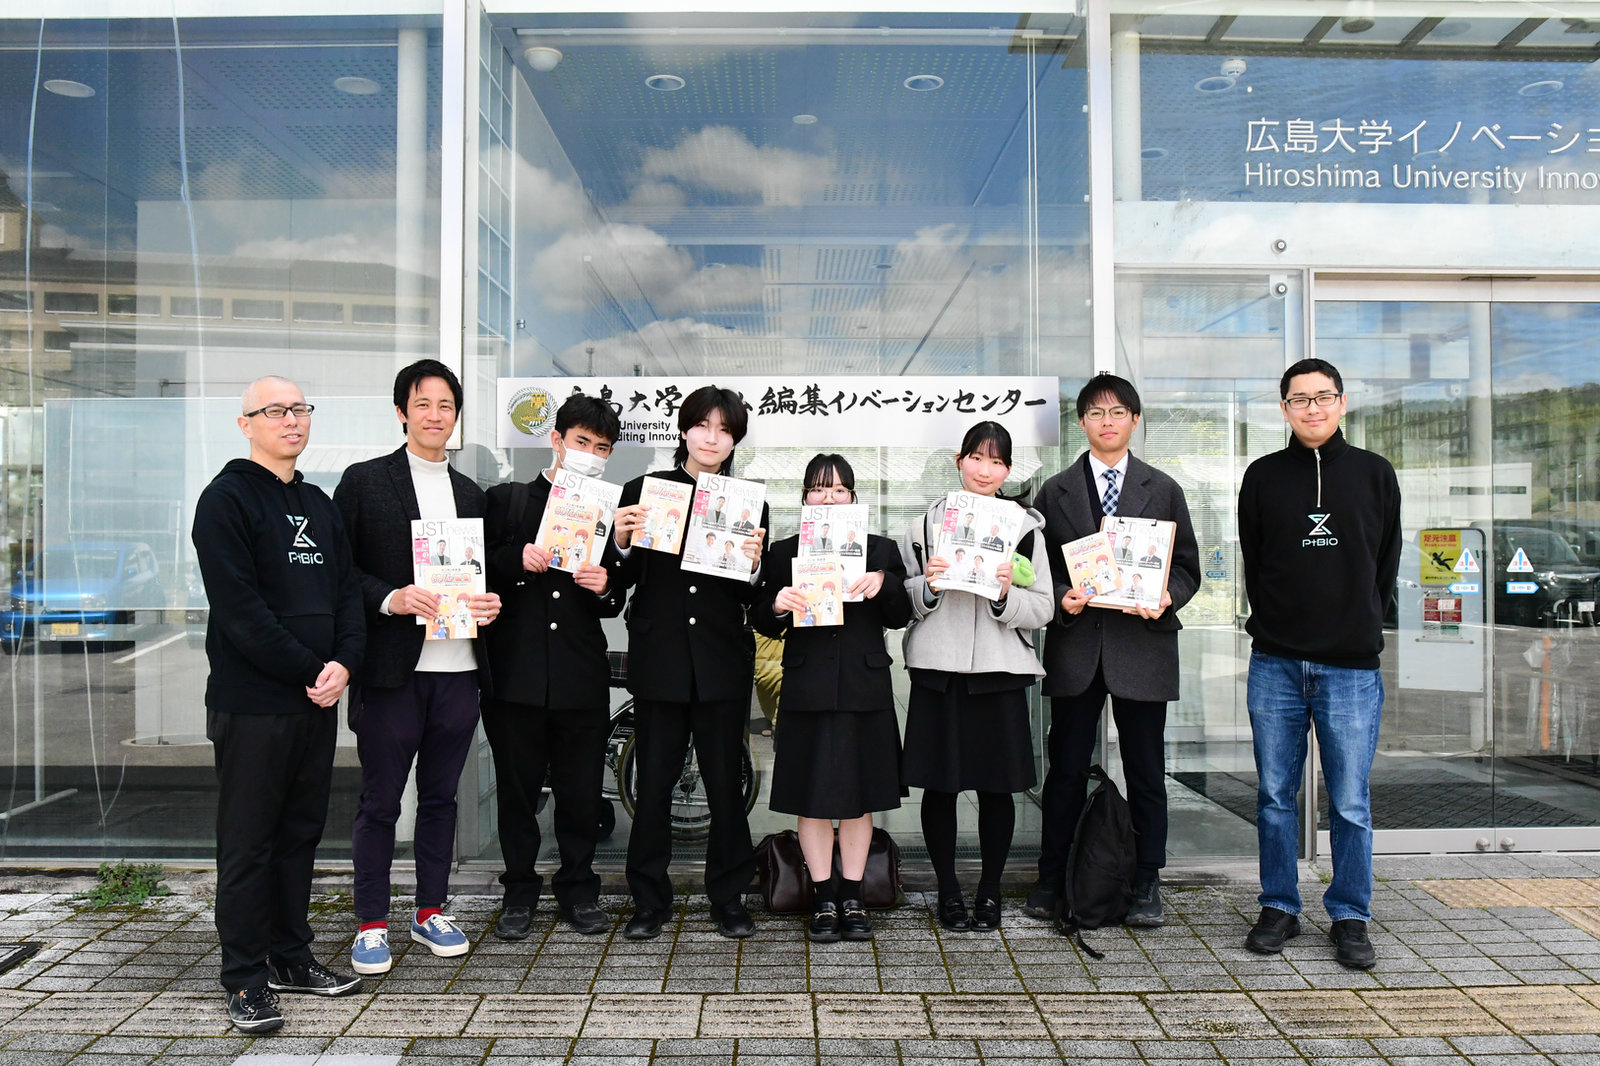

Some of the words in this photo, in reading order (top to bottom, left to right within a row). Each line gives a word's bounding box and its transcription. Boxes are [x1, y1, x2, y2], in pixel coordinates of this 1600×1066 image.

[1245, 162, 1381, 189] Hiroshima
[1392, 163, 1527, 194] University
[1537, 165, 1600, 190] Inno
[620, 420, 671, 431] University
[618, 432, 646, 443] diting
